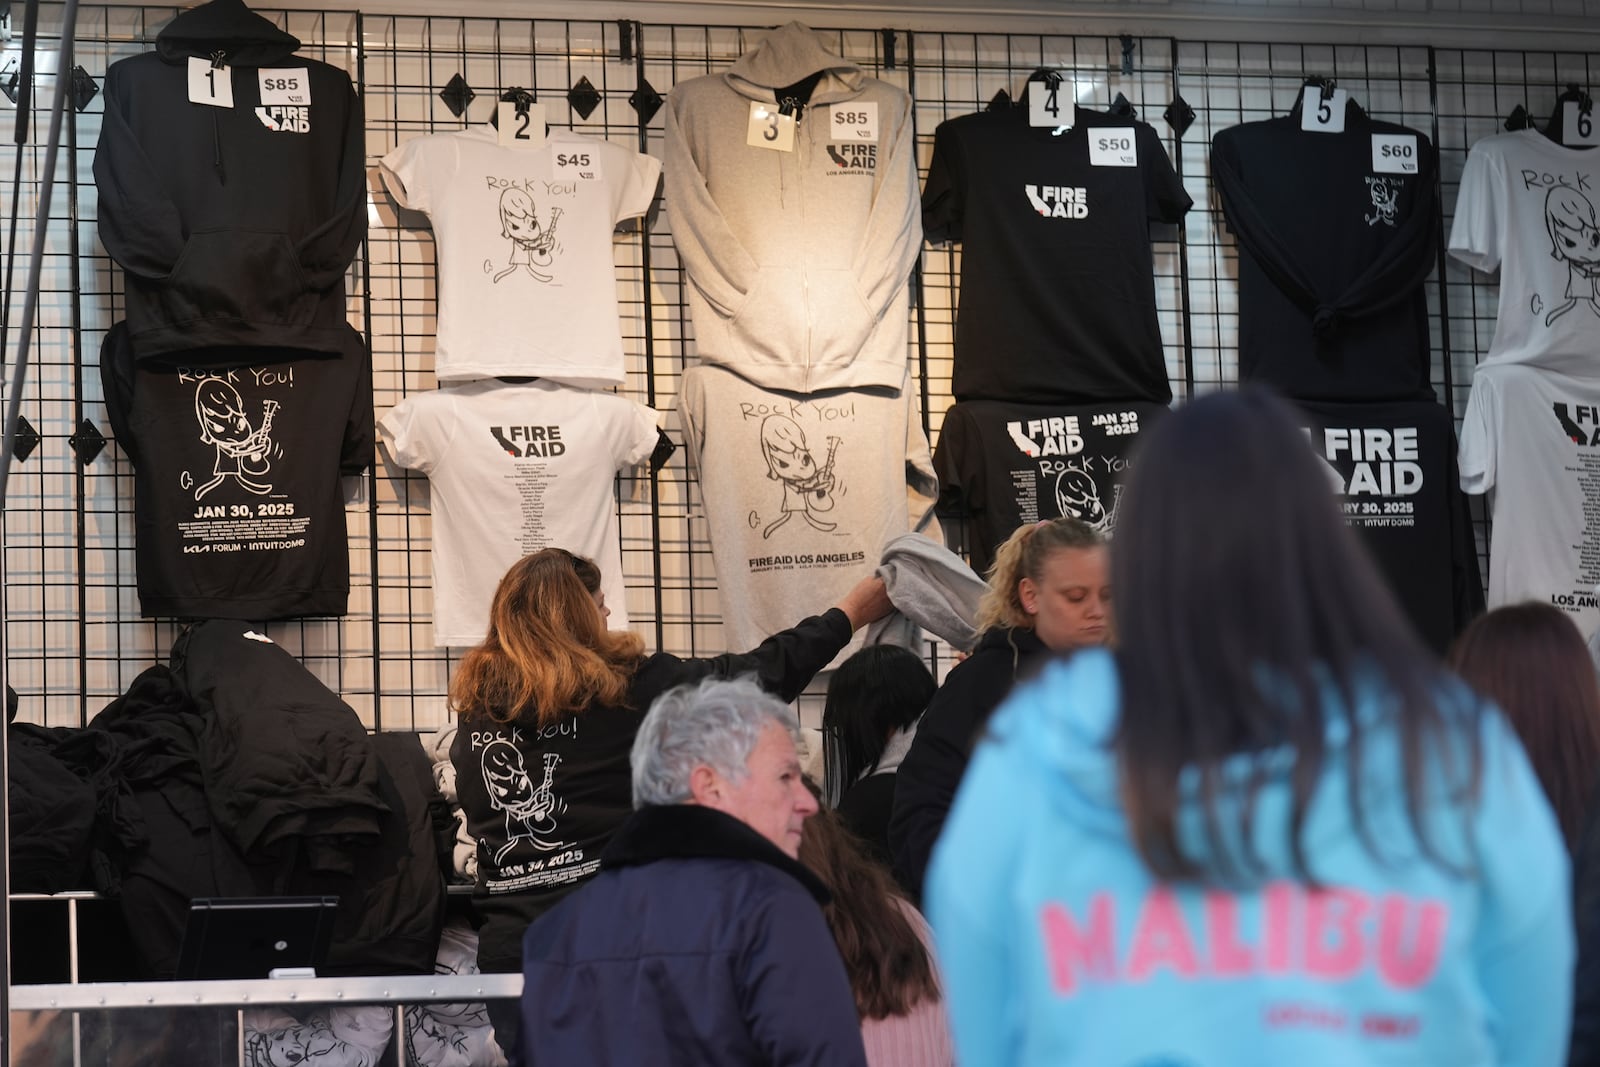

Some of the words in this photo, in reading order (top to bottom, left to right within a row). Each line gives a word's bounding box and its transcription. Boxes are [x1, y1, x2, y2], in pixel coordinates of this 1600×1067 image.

[205, 69, 215, 98] 1
[264, 78, 298, 91] $85
[1044, 87, 1059, 118] 4
[1317, 97, 1331, 124] 5
[270, 106, 309, 120] FIRE
[835, 111, 868, 125] $85
[280, 119, 311, 133] AID
[515, 111, 530, 140] 2
[763, 111, 779, 141] 3
[1577, 110, 1592, 138] 6
[841, 144, 877, 156] FIRE
[1098, 138, 1130, 151] $50
[1381, 144, 1412, 158] $60
[557, 153, 590, 167] $45
[850, 156, 876, 169] AID
[486, 176, 535, 192] ROCK
[542, 180, 577, 198] YOU!
[1521, 169, 1591, 191] ROCK
[1042, 185, 1087, 203] FIRE
[1051, 202, 1089, 219] AID
[176, 367, 240, 384] ROCK
[250, 367, 293, 388] YOU!
[740, 401, 803, 421] ROCK
[811, 401, 855, 421] YOU!
[1091, 412, 1117, 426] JAN
[1119, 411, 1138, 424] 30
[1576, 404, 1599, 425] FI
[510, 426, 561, 441] FIRE
[1027, 416, 1080, 439] FIRE
[1105, 421, 1139, 436] 2025
[524, 441, 566, 457] AID
[1041, 434, 1084, 456] AID
[1324, 427, 1419, 461] FIRE
[1039, 455, 1094, 478] ROCK
[1348, 461, 1424, 495] AID
[194, 506, 226, 518] JAN
[230, 504, 254, 519] 30,
[258, 503, 294, 516] 2025
[1362, 502, 1381, 515] 30,
[1384, 502, 1414, 514] 2025
[213, 543, 241, 553] FORUM
[748, 555, 793, 568] FIREAID
[795, 554, 814, 564] LOS
[815, 551, 865, 563] ANGELES
[1551, 594, 1575, 606] LOS
[471, 726, 523, 751] ROCK
[500, 864, 524, 878] JAN
[548, 849, 584, 867] 2025
[1041, 881, 1449, 996] MALIBU
